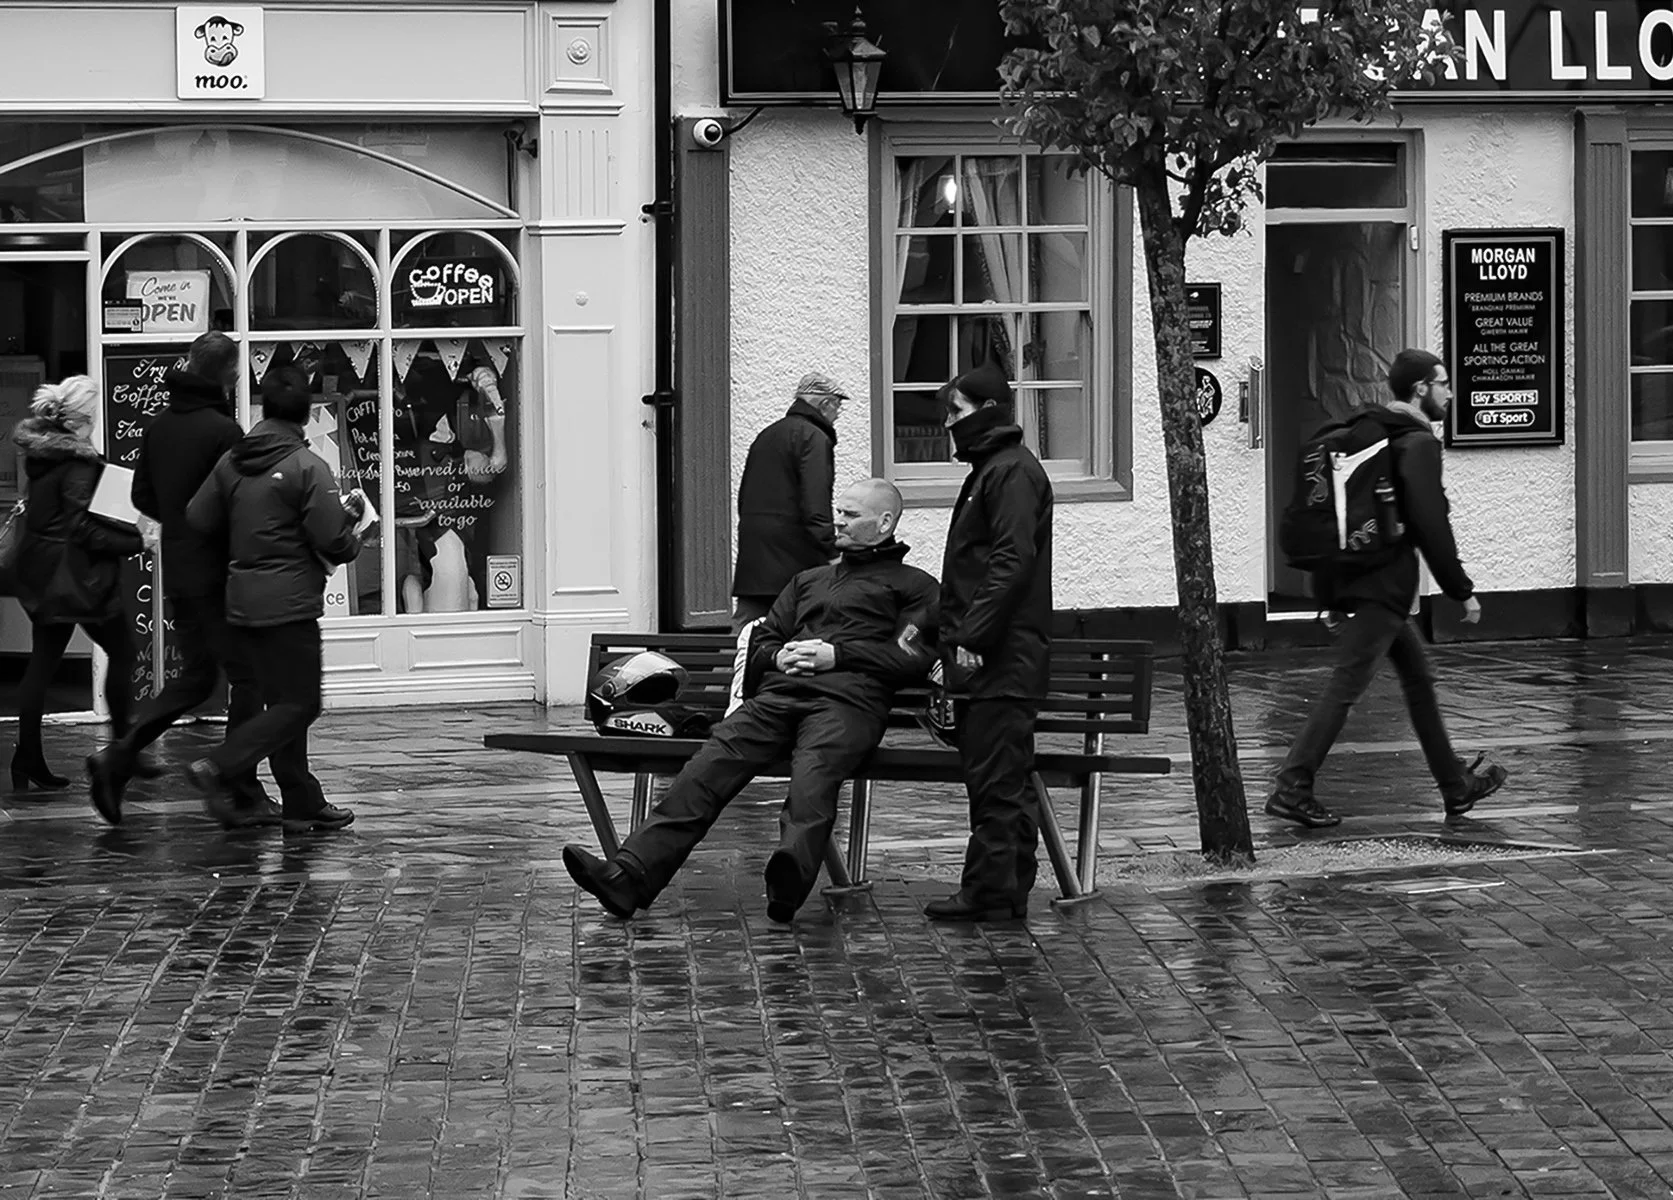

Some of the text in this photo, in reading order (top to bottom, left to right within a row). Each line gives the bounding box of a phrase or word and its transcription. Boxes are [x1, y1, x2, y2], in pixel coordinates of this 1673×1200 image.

[1471, 247, 1535, 264] MORGAN
[1480, 264, 1528, 280] LLOYD
[141, 276, 191, 297] Come in
[445, 286, 493, 305] OPEN
[1464, 291, 1544, 302] PREMIUM BRANDS
[1475, 316, 1534, 328] GREAT VALUE
[1472, 341, 1539, 353] ALL THE GREAT
[1464, 354, 1545, 366] SPORTING ACTION
[132, 358, 168, 383] Try
[112, 384, 170, 409] Coffee
[1473, 392, 1535, 405] sky SPORTS
[1482, 412, 1528, 425] BT Sport
[115, 420, 143, 440] Tea
[447, 481, 466, 492] or
[419, 494, 495, 510] available
[437, 514, 477, 529] to go
[613, 718, 667, 734] SHARK
